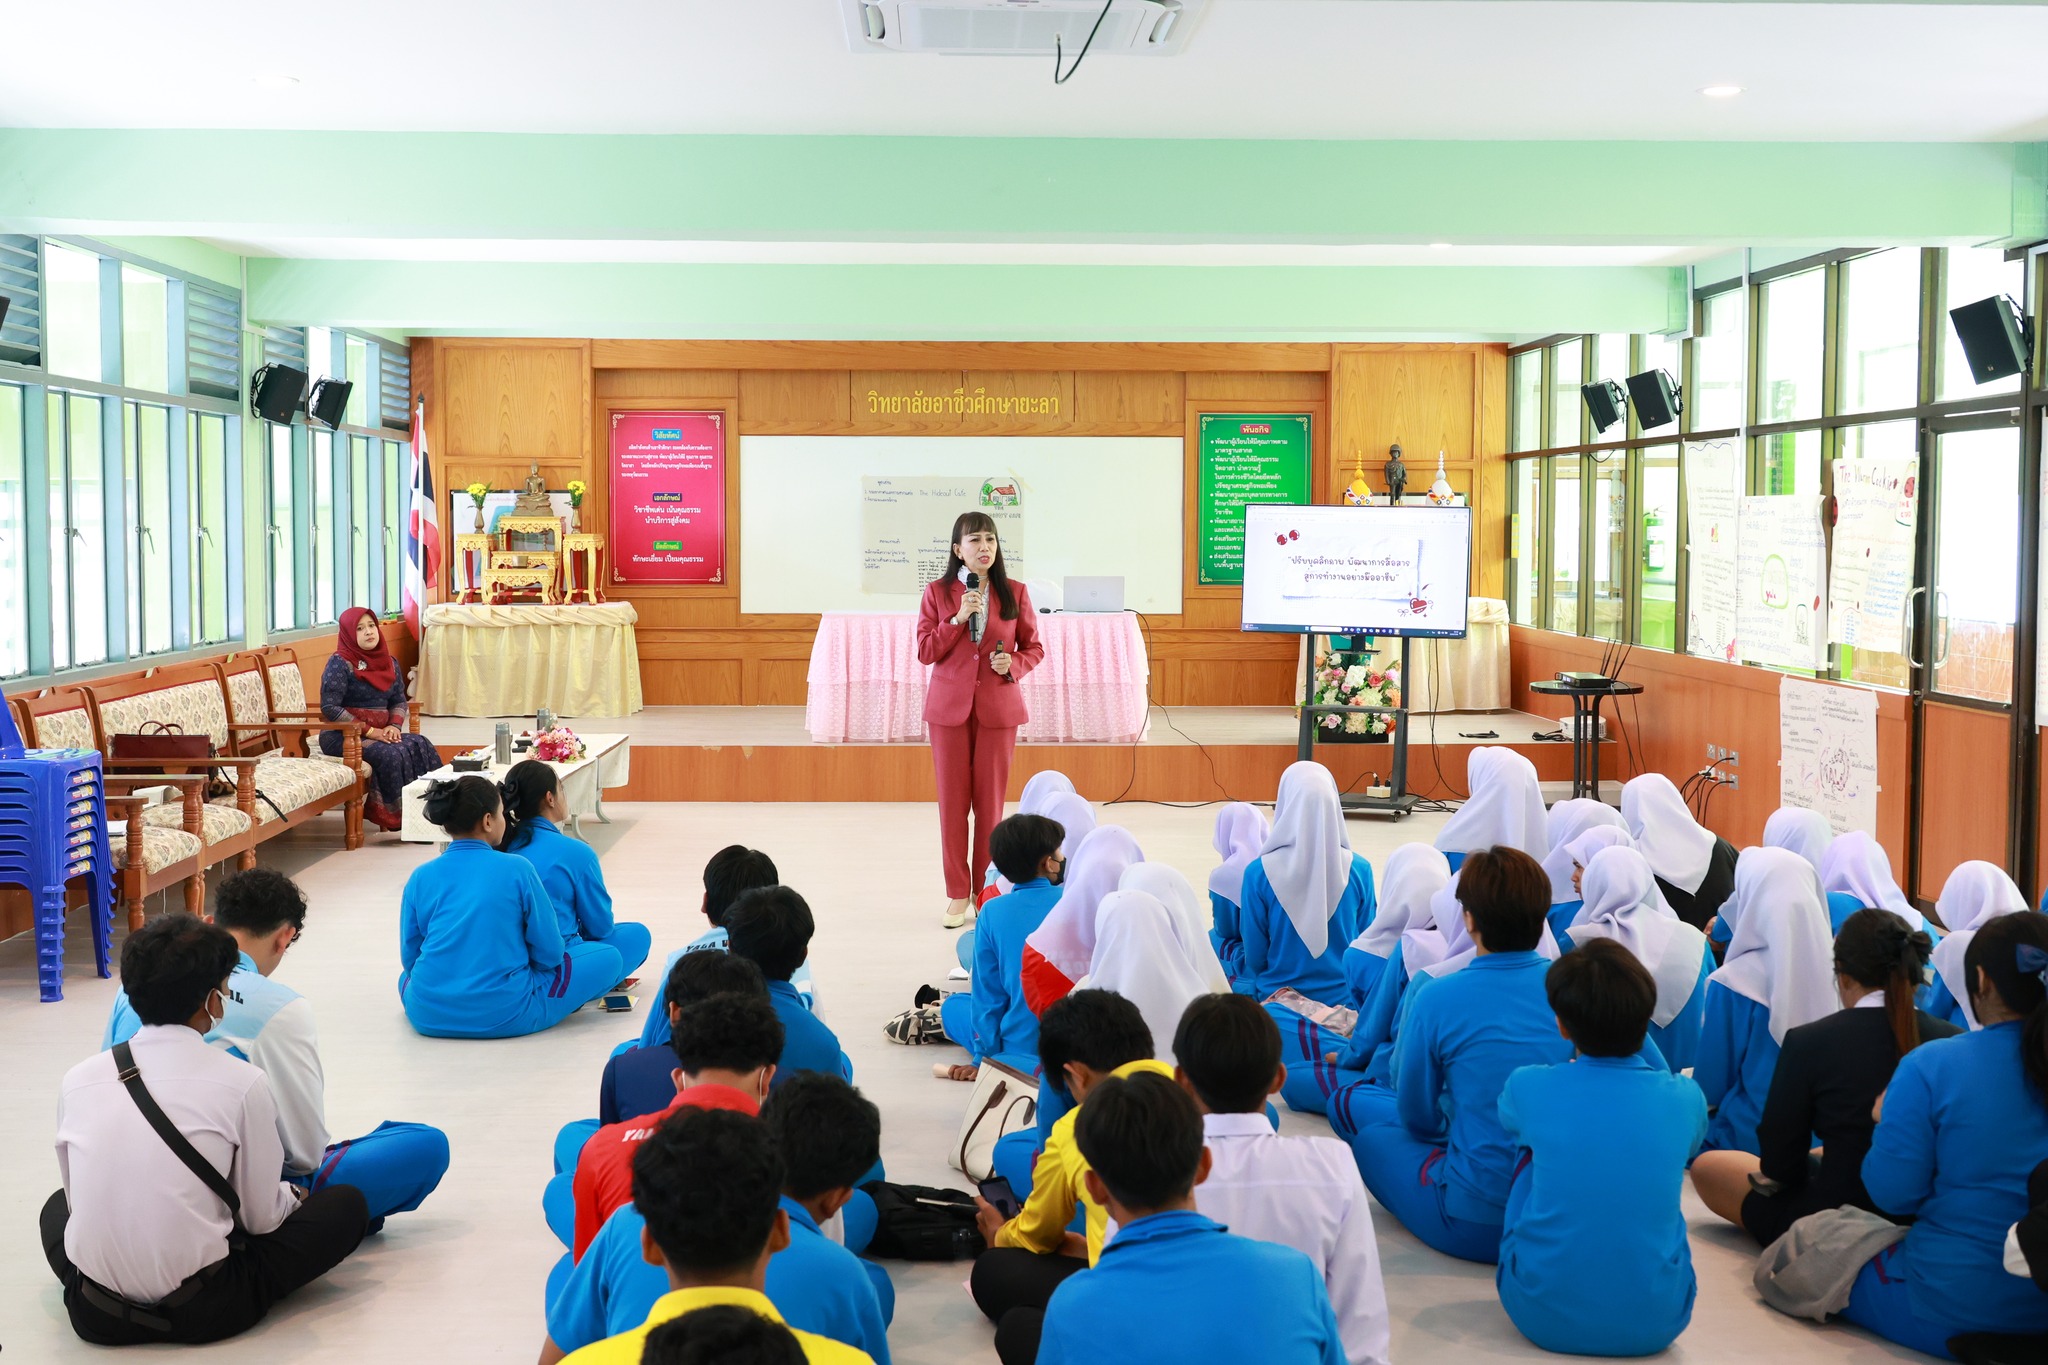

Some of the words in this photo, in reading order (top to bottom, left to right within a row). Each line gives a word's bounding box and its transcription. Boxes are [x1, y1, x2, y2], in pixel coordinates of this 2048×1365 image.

[867, 387, 1059, 414] วิทยาลัยอาชีวศึกษายะลา
[1242, 425, 1269, 434] พันธกิจ
[654, 493, 681, 501] เอกลักษณ์
[931, 489, 952, 497] Hideout
[666, 505, 701, 515] เน้นคุณธรรม
[645, 516, 691, 526] นำบริการสู่สังคม
[665, 553, 704, 564] เปี่ยมคุณธรรม
[1347, 555, 1411, 567] พัฒนาการสื่อสาร
